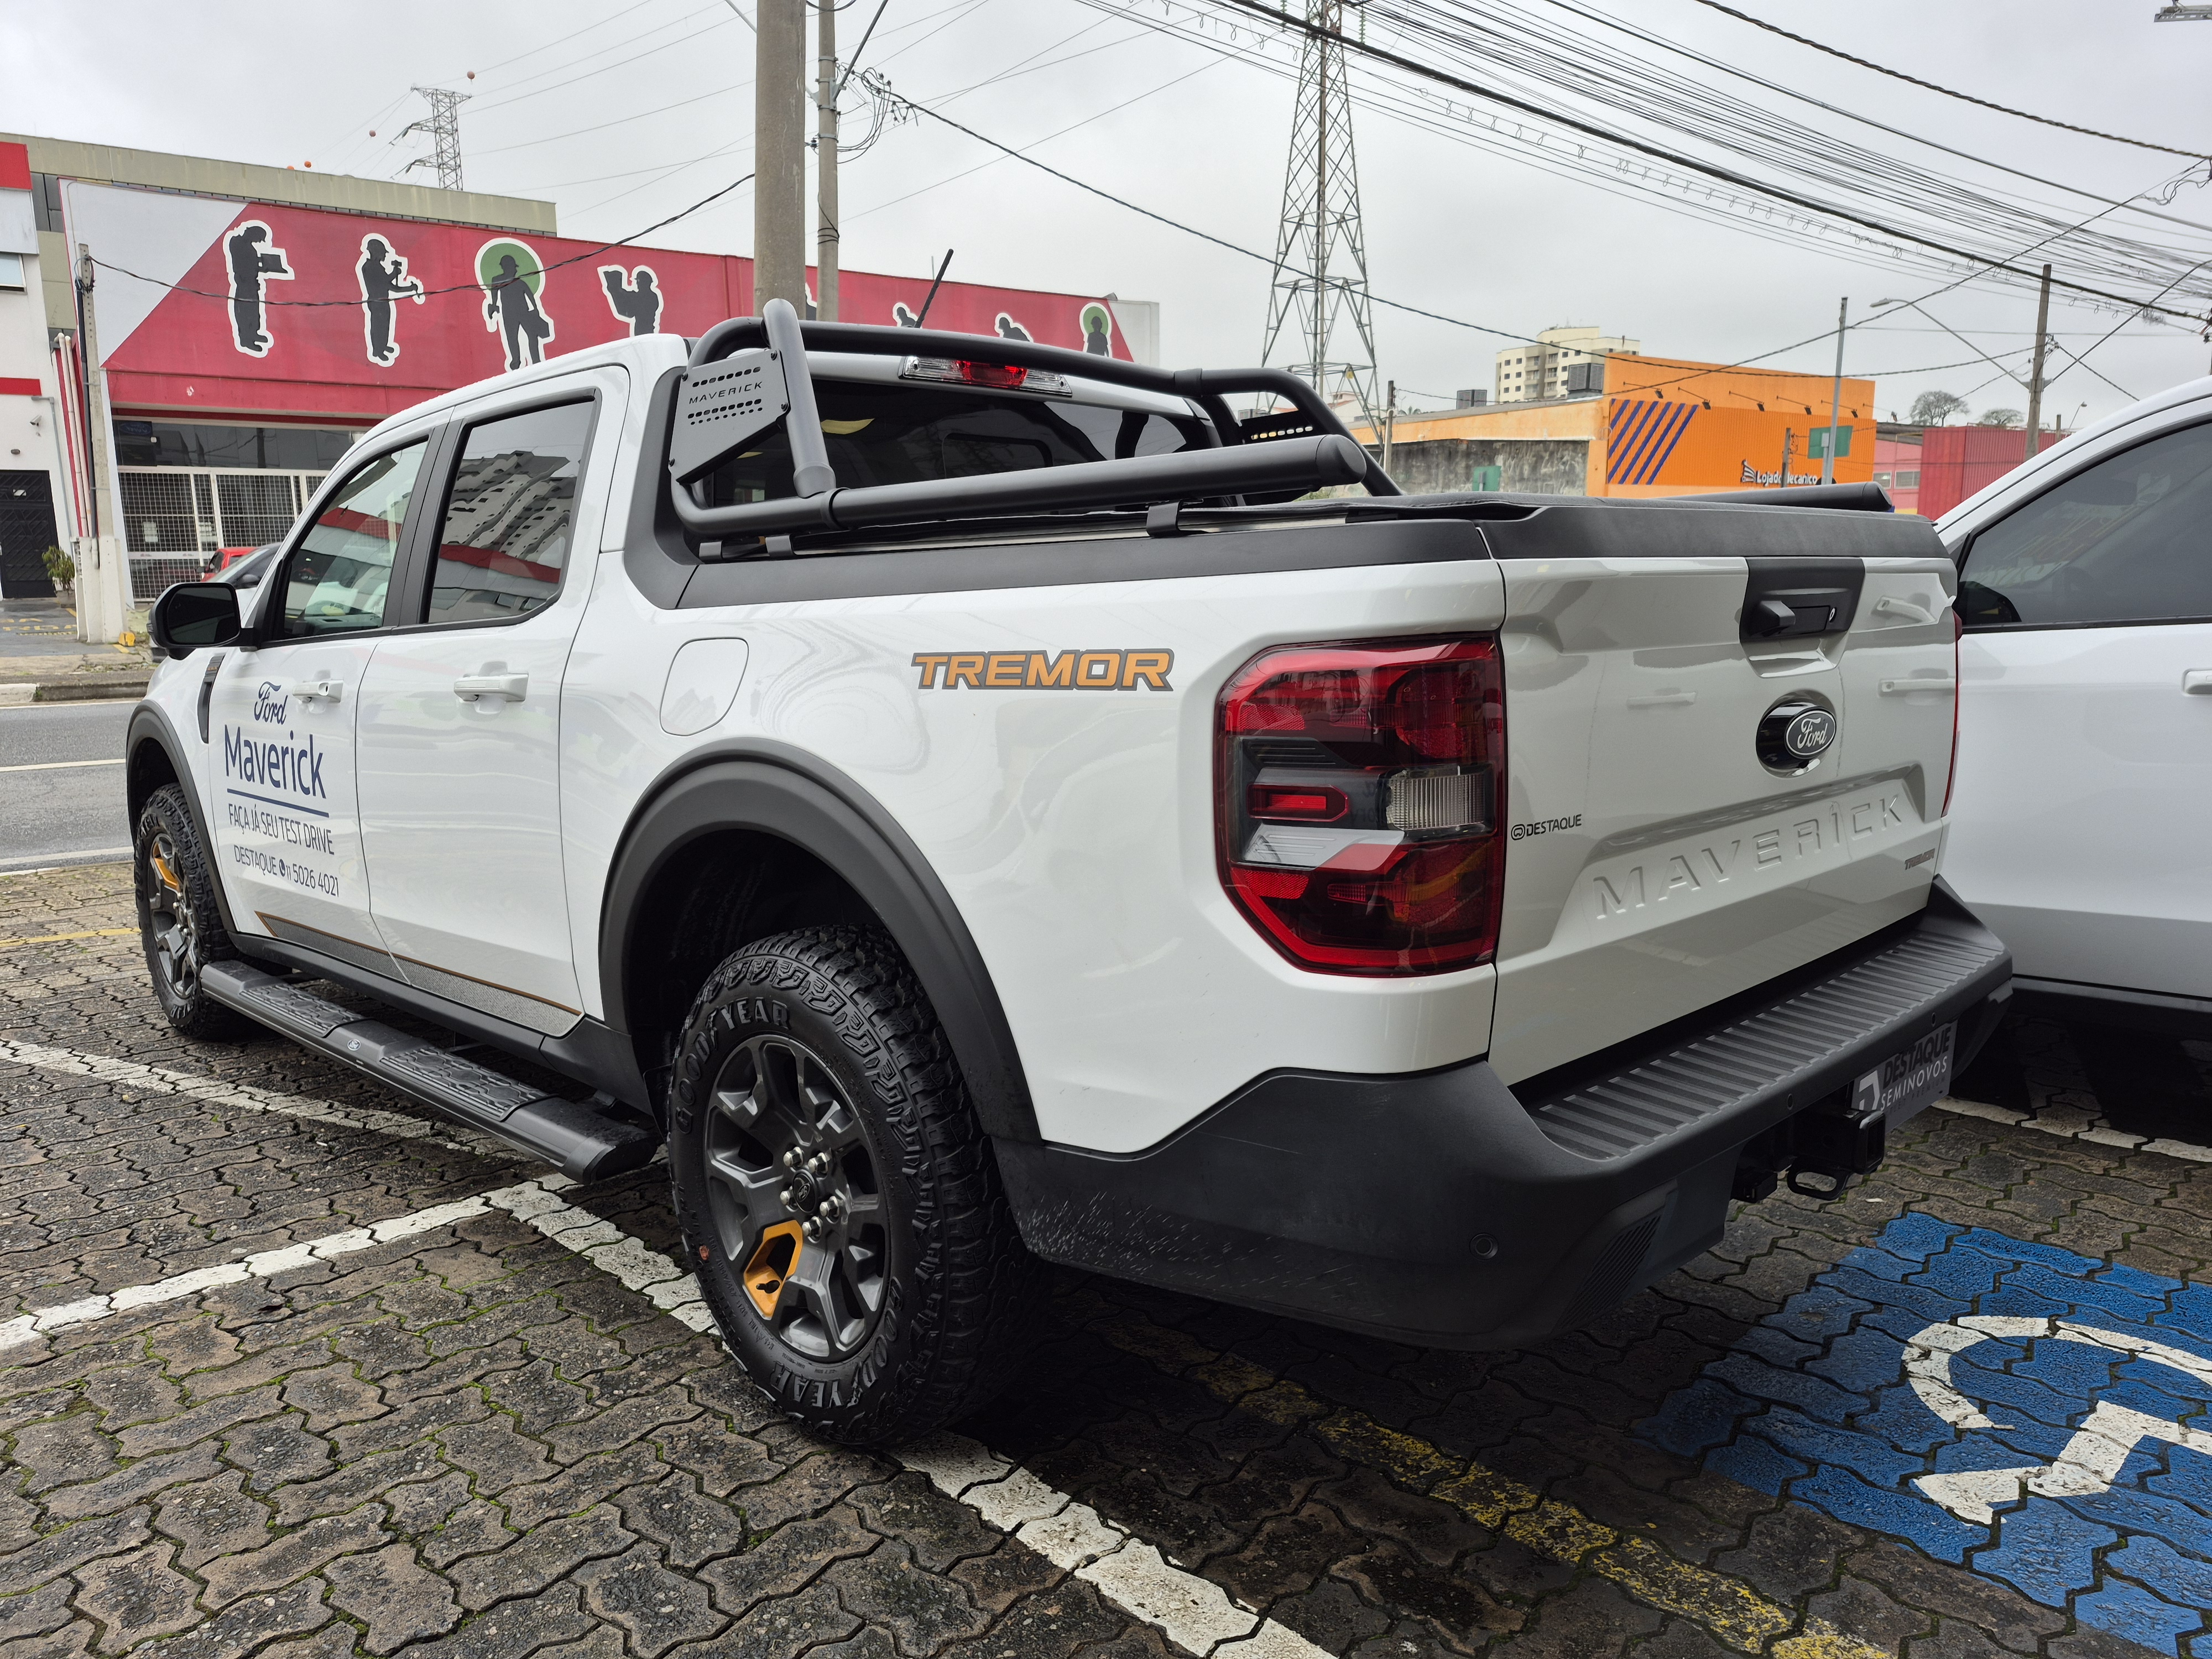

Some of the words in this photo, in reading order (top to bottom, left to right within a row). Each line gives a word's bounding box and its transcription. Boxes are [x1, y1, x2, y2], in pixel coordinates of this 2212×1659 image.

[688, 381, 763, 405] MAVERICK
[911, 649, 1173, 691] TREMOR
[254, 681, 288, 725] Ford
[1797, 717, 1828, 749] Ford
[224, 724, 326, 799] Maverick
[228, 804, 251, 834] FAÇA
[251, 804, 261, 833] JÁ
[260, 811, 279, 838] SEU
[279, 816, 301, 846] TEST
[303, 823, 335, 855] DRIVE
[234, 844, 277, 876] DESTAQUE
[293, 863, 316, 889] 5026
[318, 872, 339, 897] 4021
[1593, 794, 1902, 920] MAVERICK
[1880, 1056, 1948, 1112] SEMINOVOS
[1883, 1026, 1952, 1090] DESTAQUE
